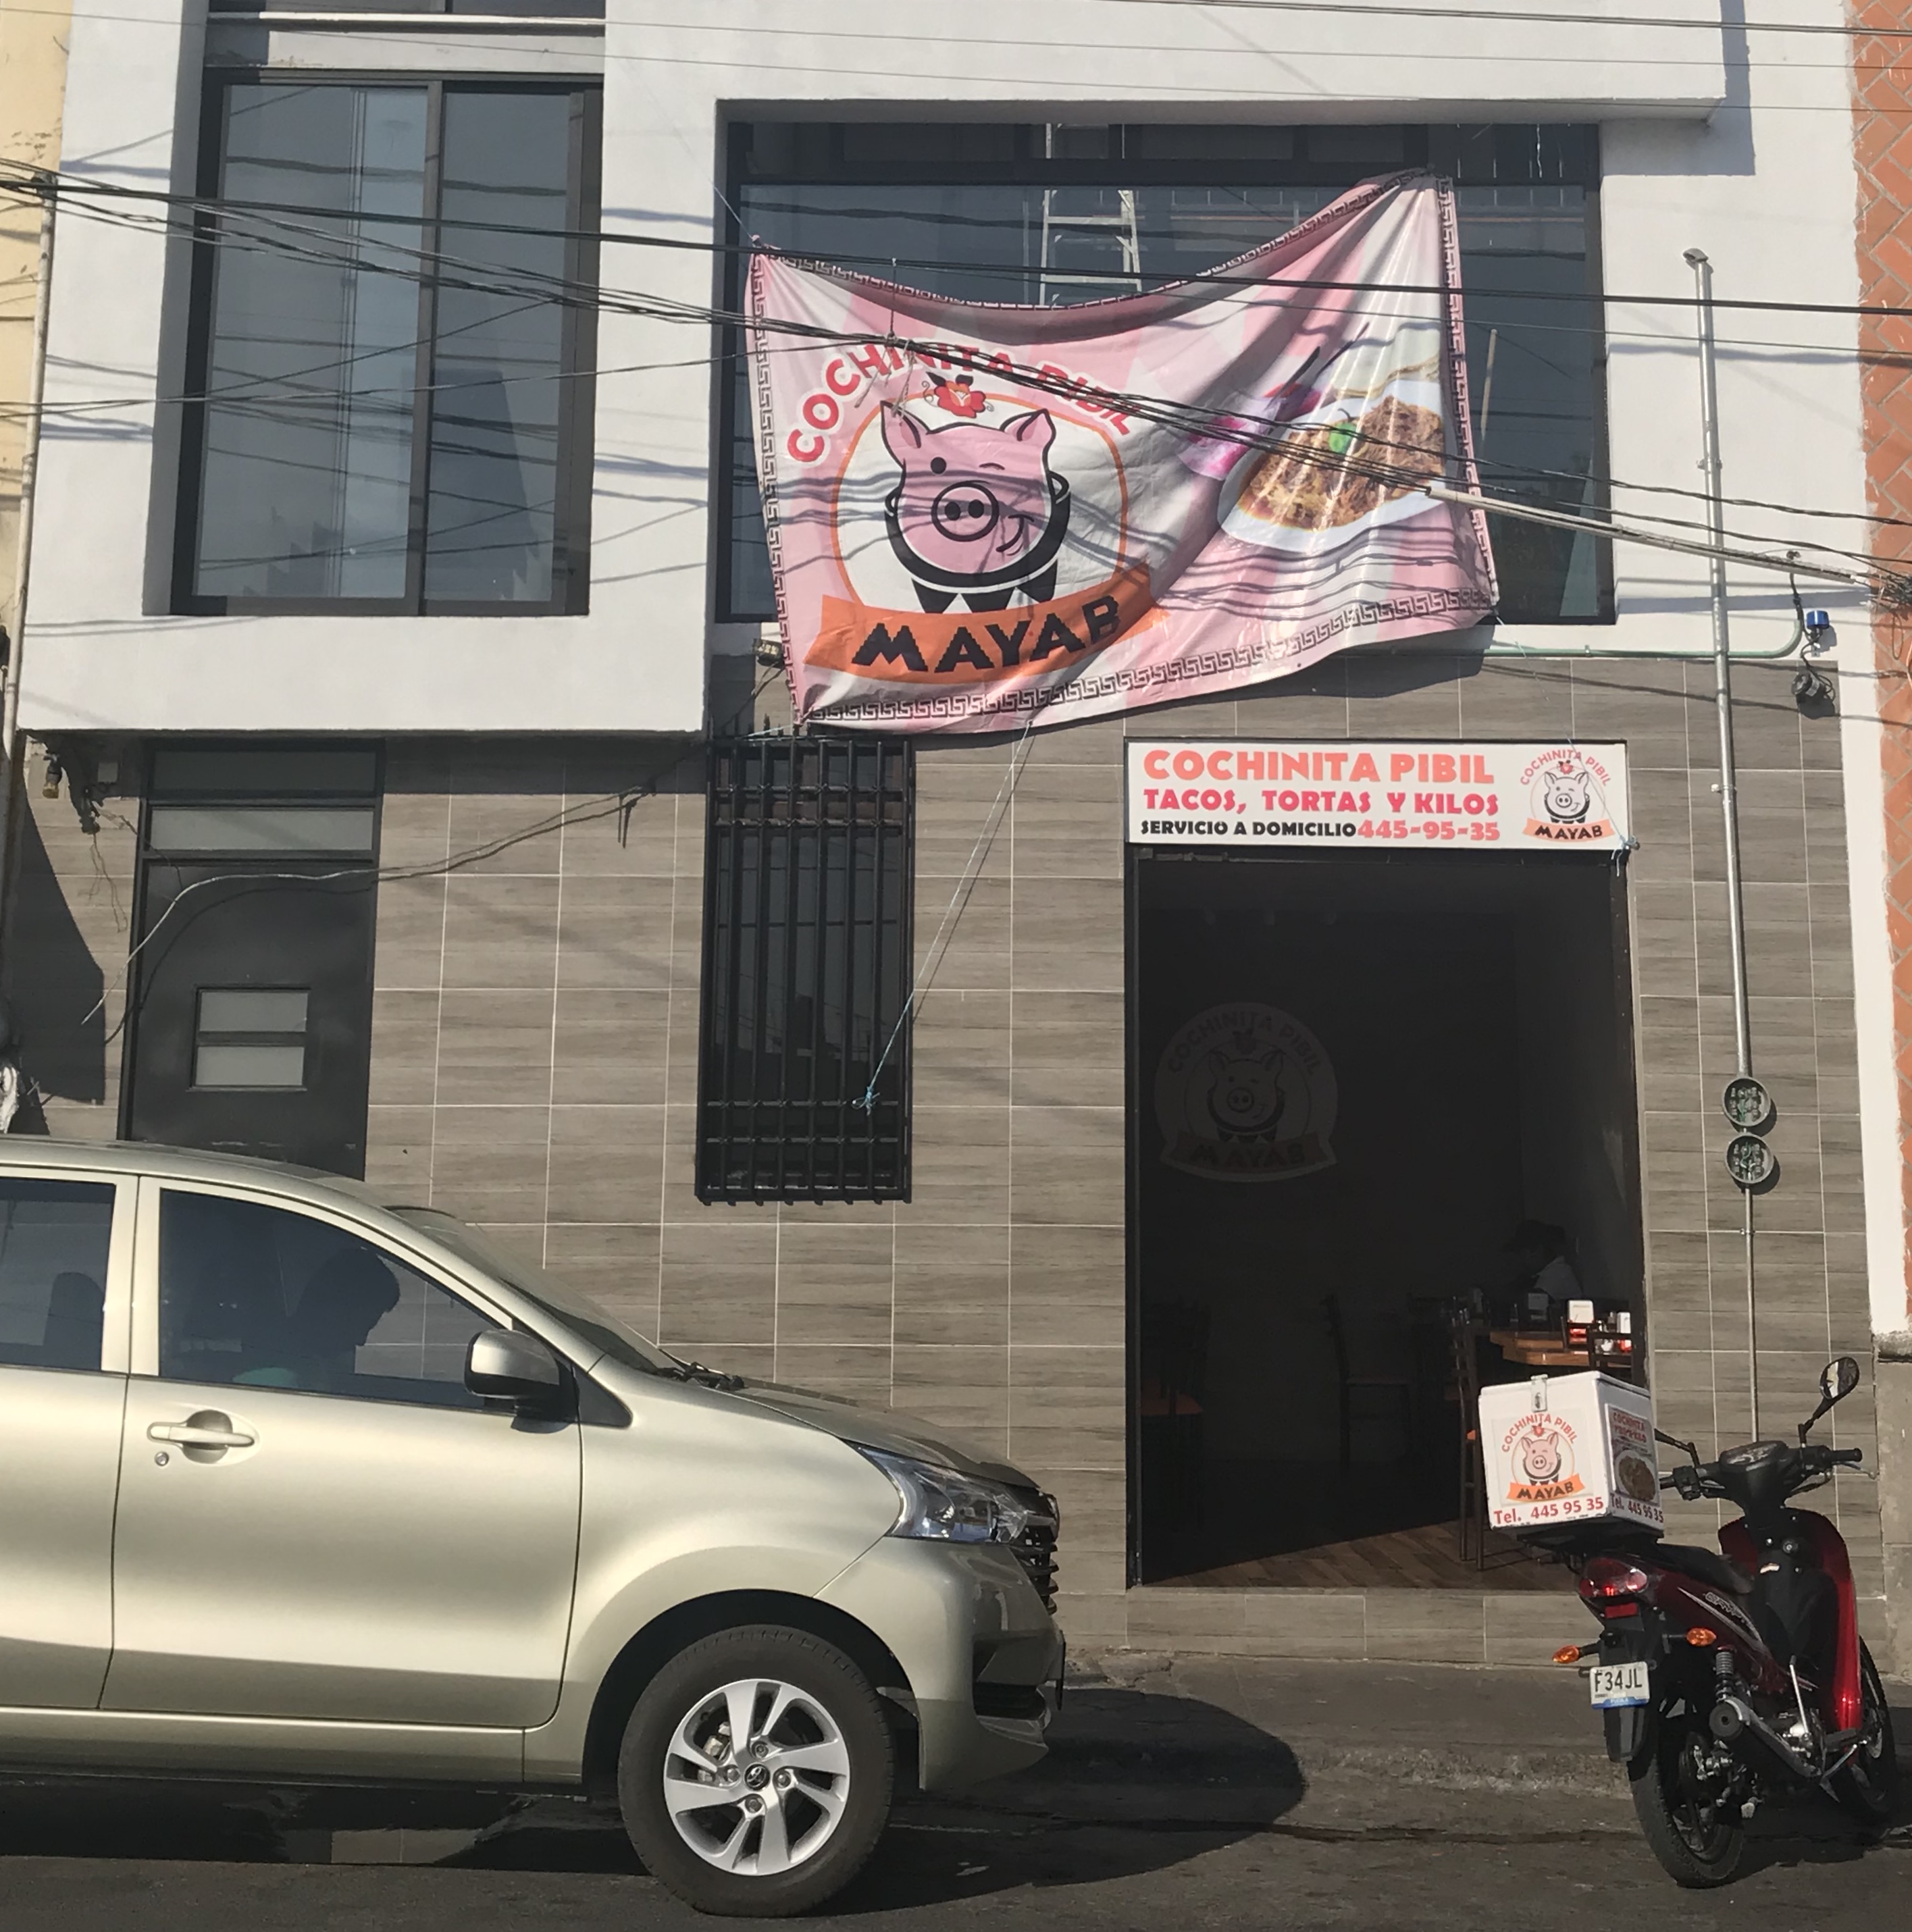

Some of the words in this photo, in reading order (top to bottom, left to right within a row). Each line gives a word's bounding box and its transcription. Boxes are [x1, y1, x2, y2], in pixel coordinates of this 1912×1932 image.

[851, 595, 1120, 673] MAYAB
[1143, 750, 1380, 782] COCHINITA
[1391, 754, 1494, 784] PIBIL
[1520, 749, 1582, 785] COCHINITA
[1585, 756, 1611, 786] PIBIL
[1143, 789, 1247, 814] TACOS,
[1262, 790, 1371, 814] TORTAS
[1387, 792, 1406, 812] Y
[1414, 793, 1499, 816] KILOS
[1141, 820, 1228, 835] SERVICIO
[1233, 822, 1247, 835] A
[1253, 822, 1356, 837] DOMICILIO
[1358, 819, 1500, 841] 445-95-35
[1534, 825, 1603, 839] MAYAB
[1168, 1012, 1273, 1073] COCHINITA
[1279, 1024, 1322, 1076] PIBIL
[1190, 1143, 1306, 1168] MAYAB
[1501, 1413, 1551, 1453] COCHINITA
[1555, 1417, 1577, 1444] PIBIL
[1516, 1482, 1574, 1500] MAYAB
[1494, 1508, 1522, 1524] Tel.
[1530, 1504, 1558, 1519] 445
[1563, 1500, 1582, 1515] 95
[1586, 1496, 1603, 1511] 35
[1610, 1492, 1624, 1510] Tel.
[1628, 1500, 1642, 1515] 445
[1643, 1505, 1653, 1519] 95
[1654, 1508, 1663, 1523] 35
[1595, 1667, 1643, 1692] F34JL
